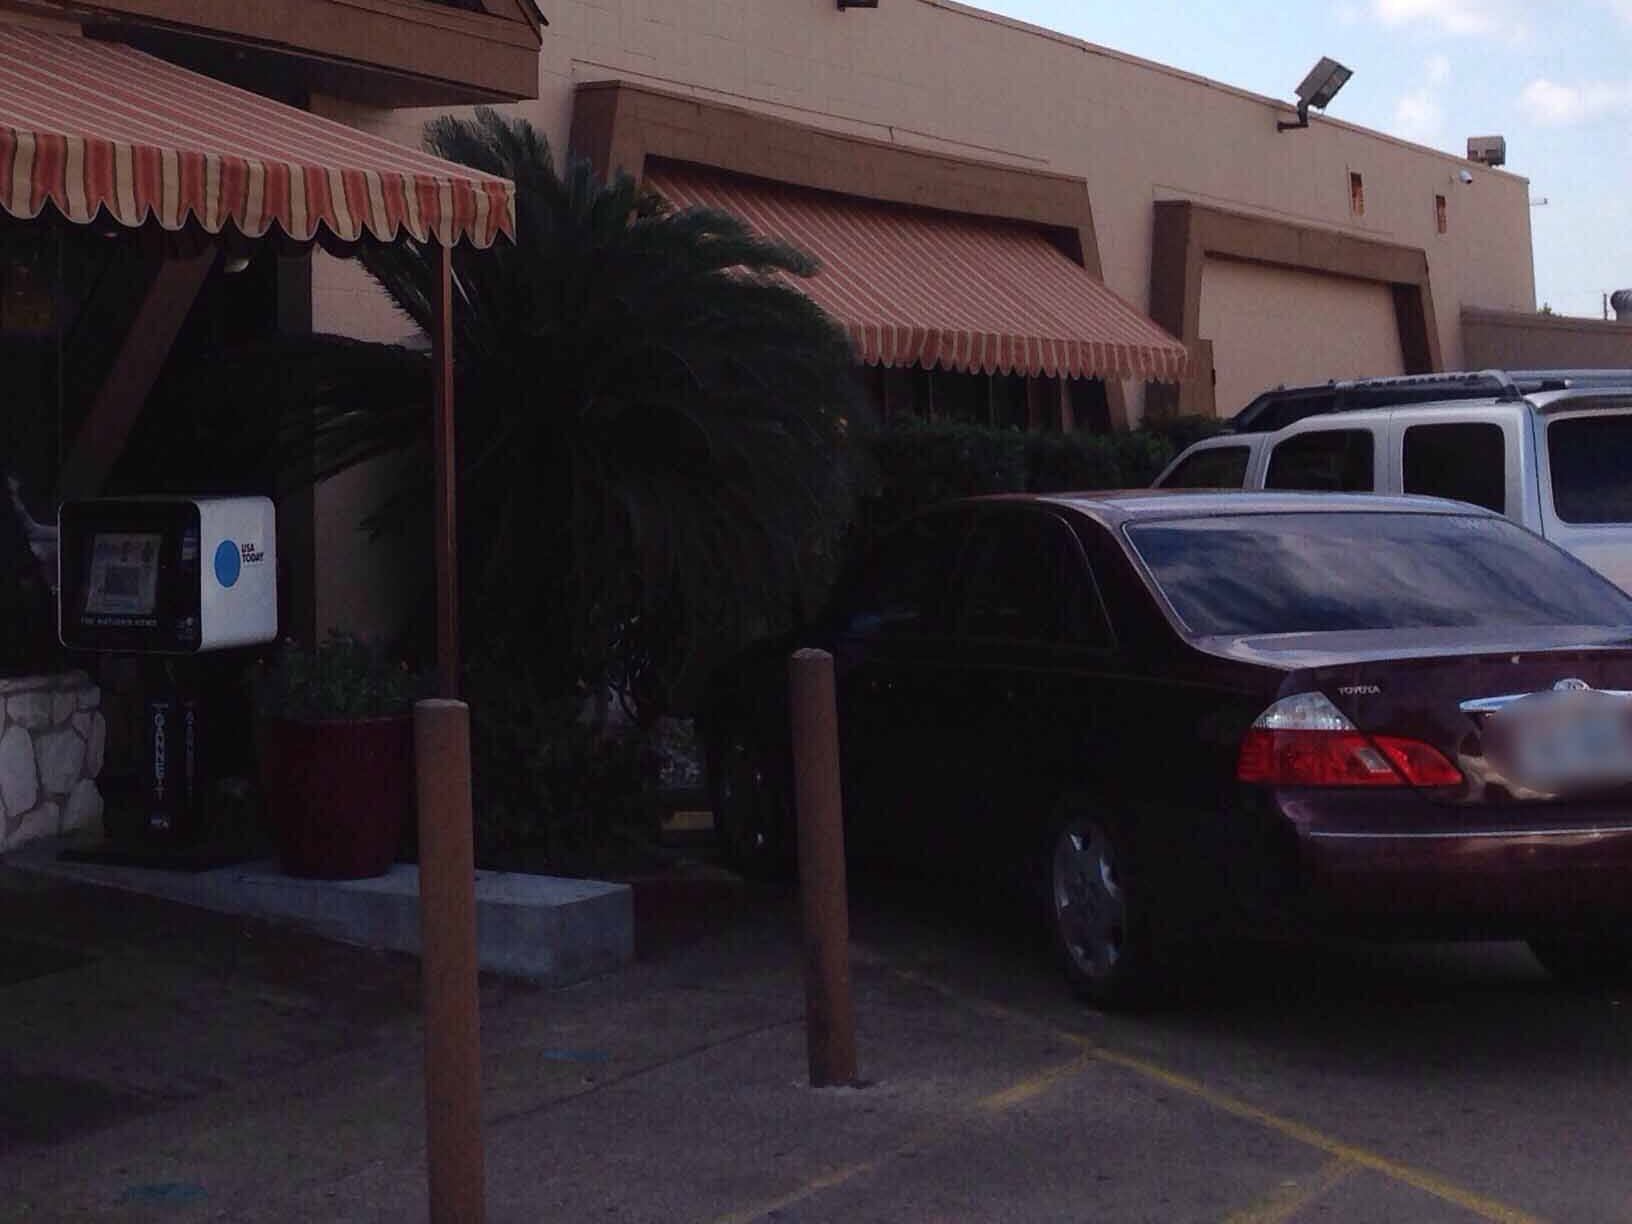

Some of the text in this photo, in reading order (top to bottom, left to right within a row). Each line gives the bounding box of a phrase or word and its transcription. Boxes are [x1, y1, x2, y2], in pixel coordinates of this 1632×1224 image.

[241, 543, 255, 553] USA
[242, 552, 265, 563] TODAY
[1337, 685, 1381, 696] TOYOTA
